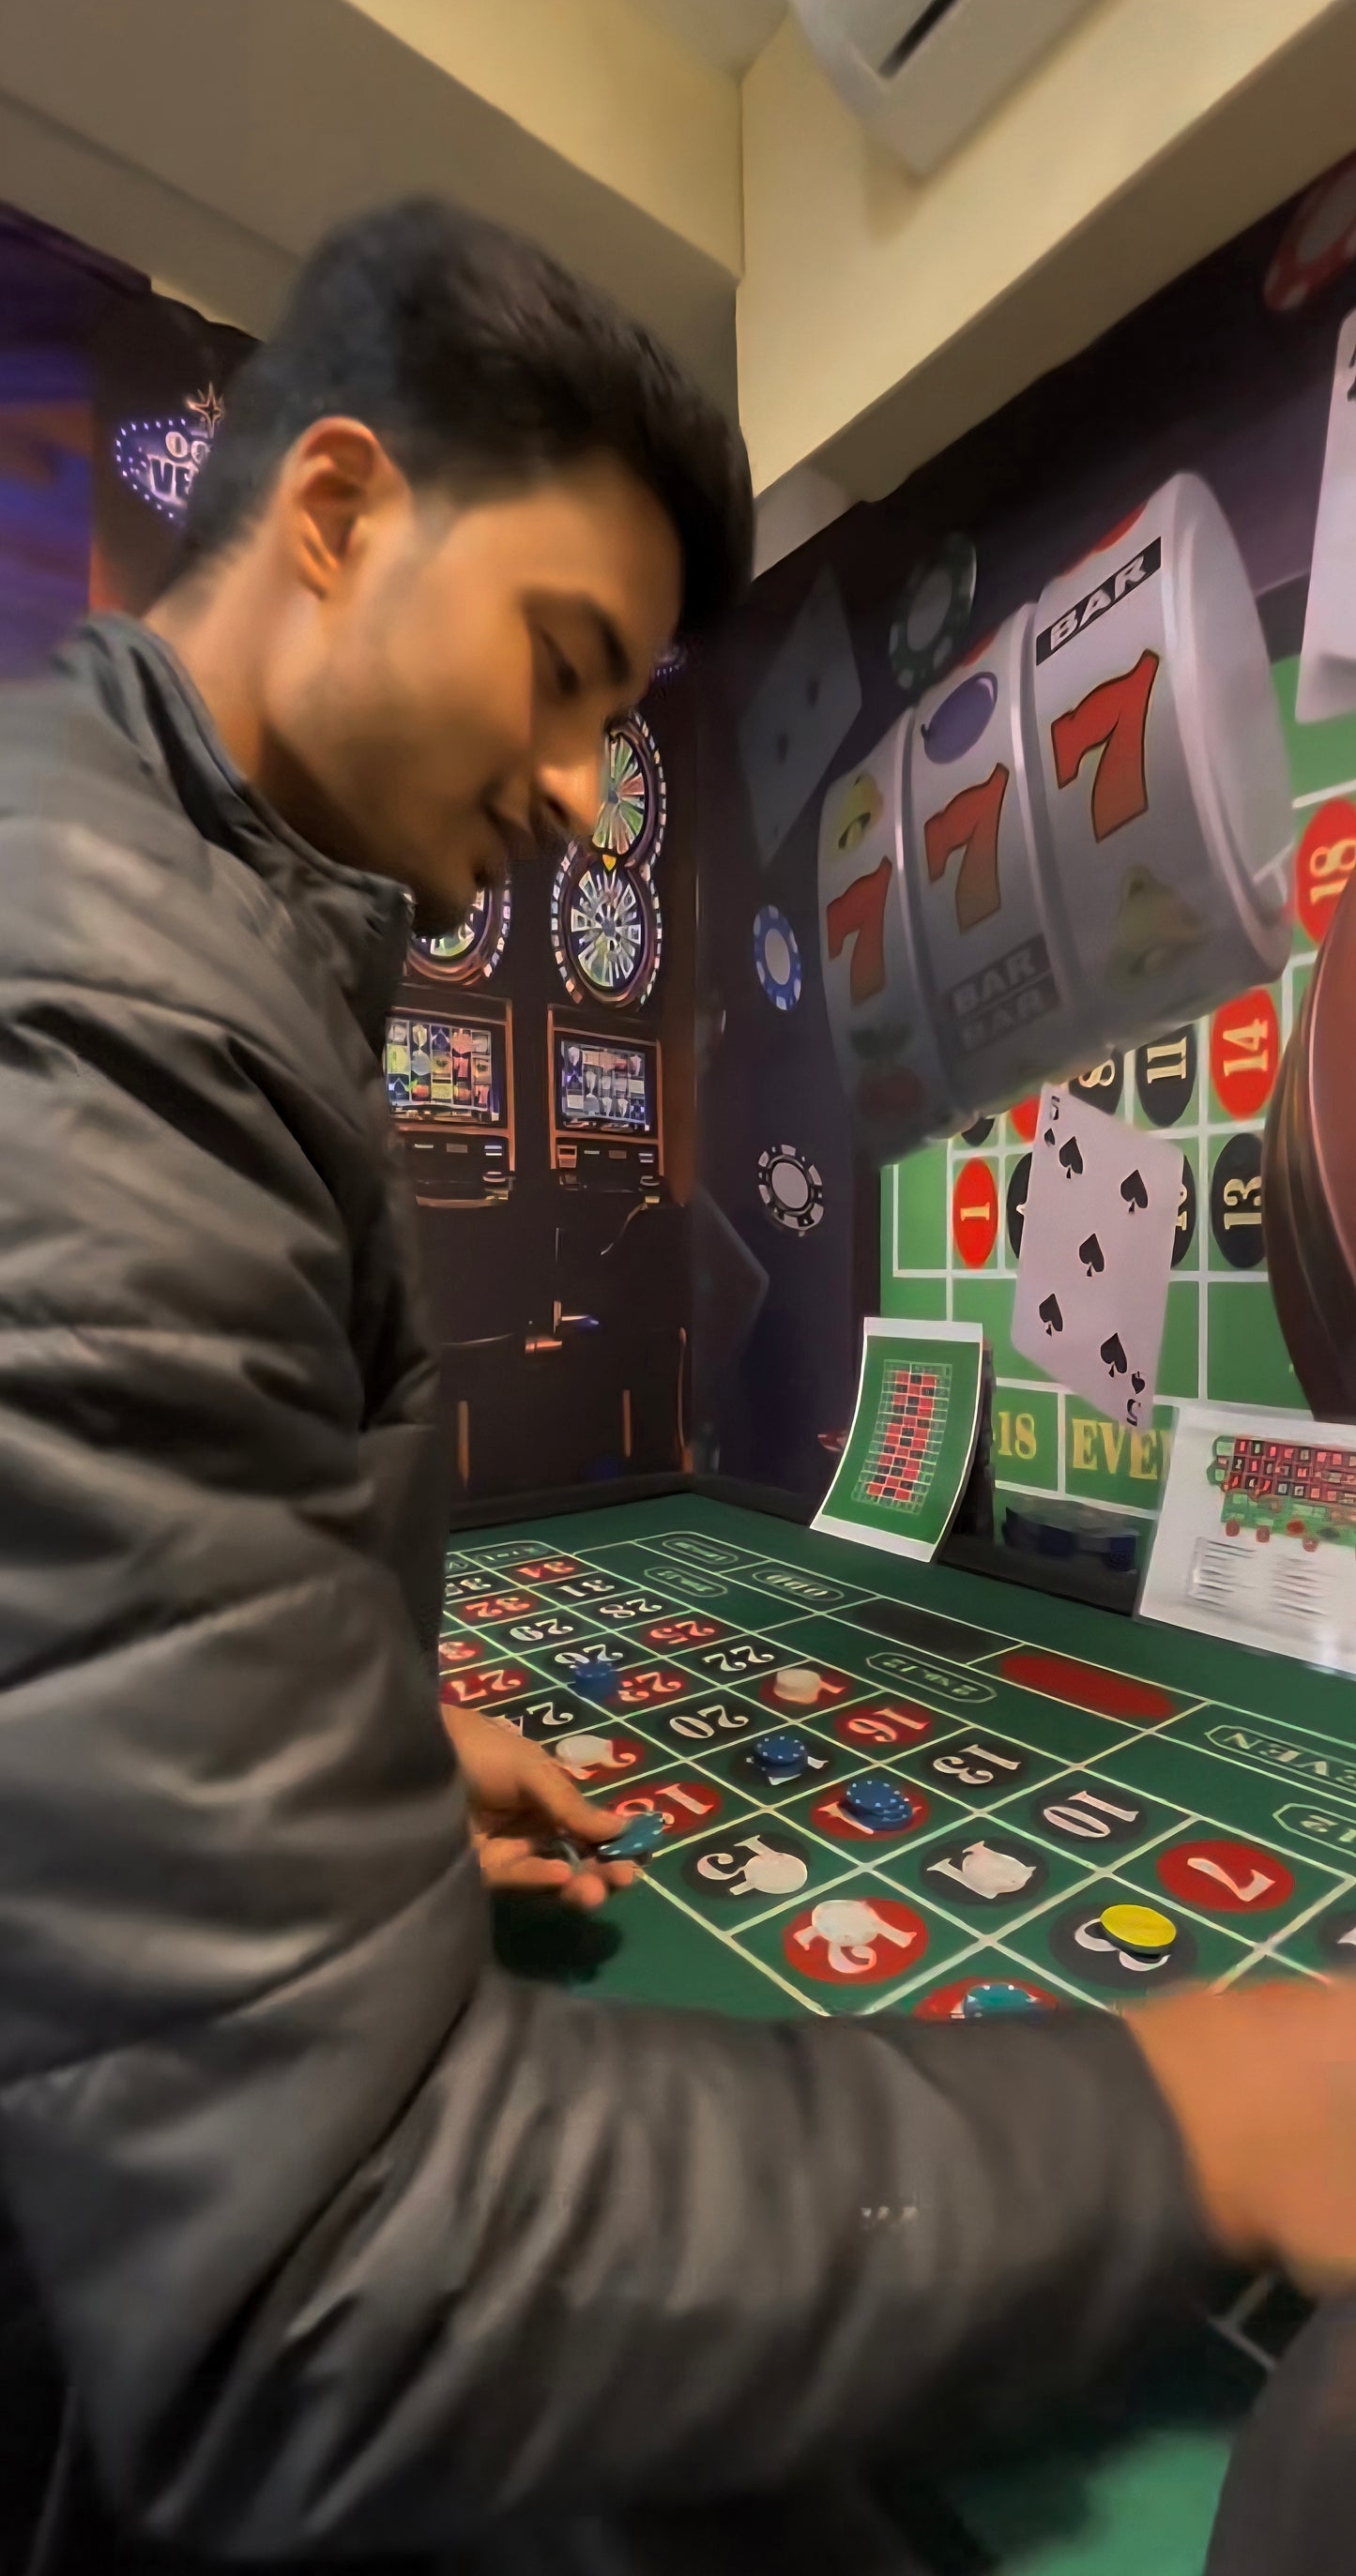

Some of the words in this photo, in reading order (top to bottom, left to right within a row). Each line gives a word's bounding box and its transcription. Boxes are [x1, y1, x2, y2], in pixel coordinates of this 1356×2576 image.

[1049, 553, 1148, 649] BAR
[1050, 648, 1160, 843] 7
[923, 762, 1010, 932] 7
[1310, 838, 1356, 905] 18
[826, 855, 893, 1008] 7
[951, 948, 1036, 1019] BAR
[1147, 1036, 1187, 1084] 11
[1223, 1019, 1269, 1077] 14
[959, 1202, 993, 1223] 1
[1224, 1176, 1263, 1231] 13
[998, 1411, 1037, 1460] 18
[465, 1597, 531, 1618] 32
[556, 1579, 616, 1598] 31
[599, 1598, 663, 1619] 28
[510, 1618, 574, 1642] 29
[650, 1620, 715, 1645] 25
[702, 1645, 775, 1673] 22
[450, 1669, 522, 1703] 27
[669, 1704, 751, 1739] 20
[847, 1707, 931, 1743] 16
[933, 1744, 1022, 1784] 13
[1043, 1790, 1139, 1839] 10
[1187, 1856, 1276, 1903] 7
